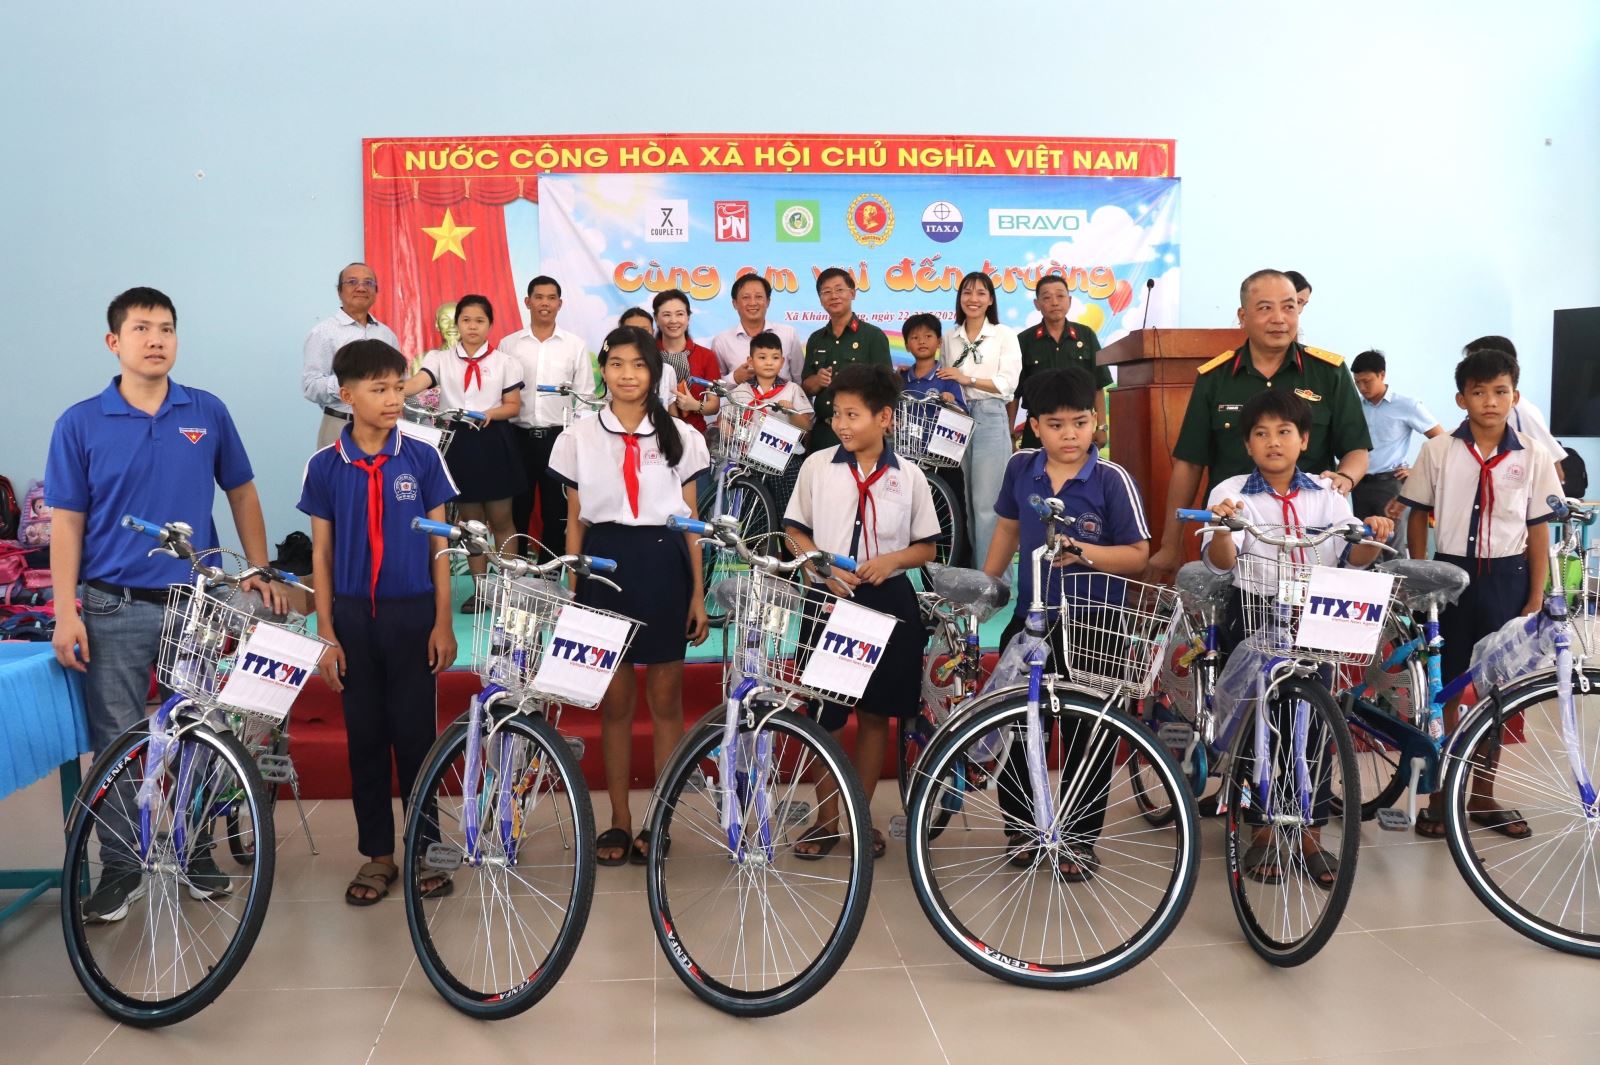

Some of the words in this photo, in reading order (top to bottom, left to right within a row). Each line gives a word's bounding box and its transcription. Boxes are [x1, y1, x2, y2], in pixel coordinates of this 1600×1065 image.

[405, 145, 499, 170] NƯỚC
[510, 143, 608, 173] CỘNG
[620, 141, 688, 167] HÒA
[700, 142, 744, 166] XÃ
[754, 142, 810, 172] HỘI
[820, 141, 887, 167] CHỦ
[897, 143, 996, 168] NGHĨA
[1005, 144, 1063, 174] VIỆT
[1073, 150, 1139, 171] NAM
[650, 228, 674, 236] COUPLE
[675, 228, 684, 236] TX
[926, 224, 959, 233] ITAXA
[998, 215, 1080, 231] BRAVO
[613, 259, 721, 301] Cùng
[785, 311, 800, 321] Xã
[872, 312, 895, 325] ngày
[101, 756, 133, 790] CENFA
[668, 931, 693, 969] CENFA
[983, 946, 1029, 969] CENFA
